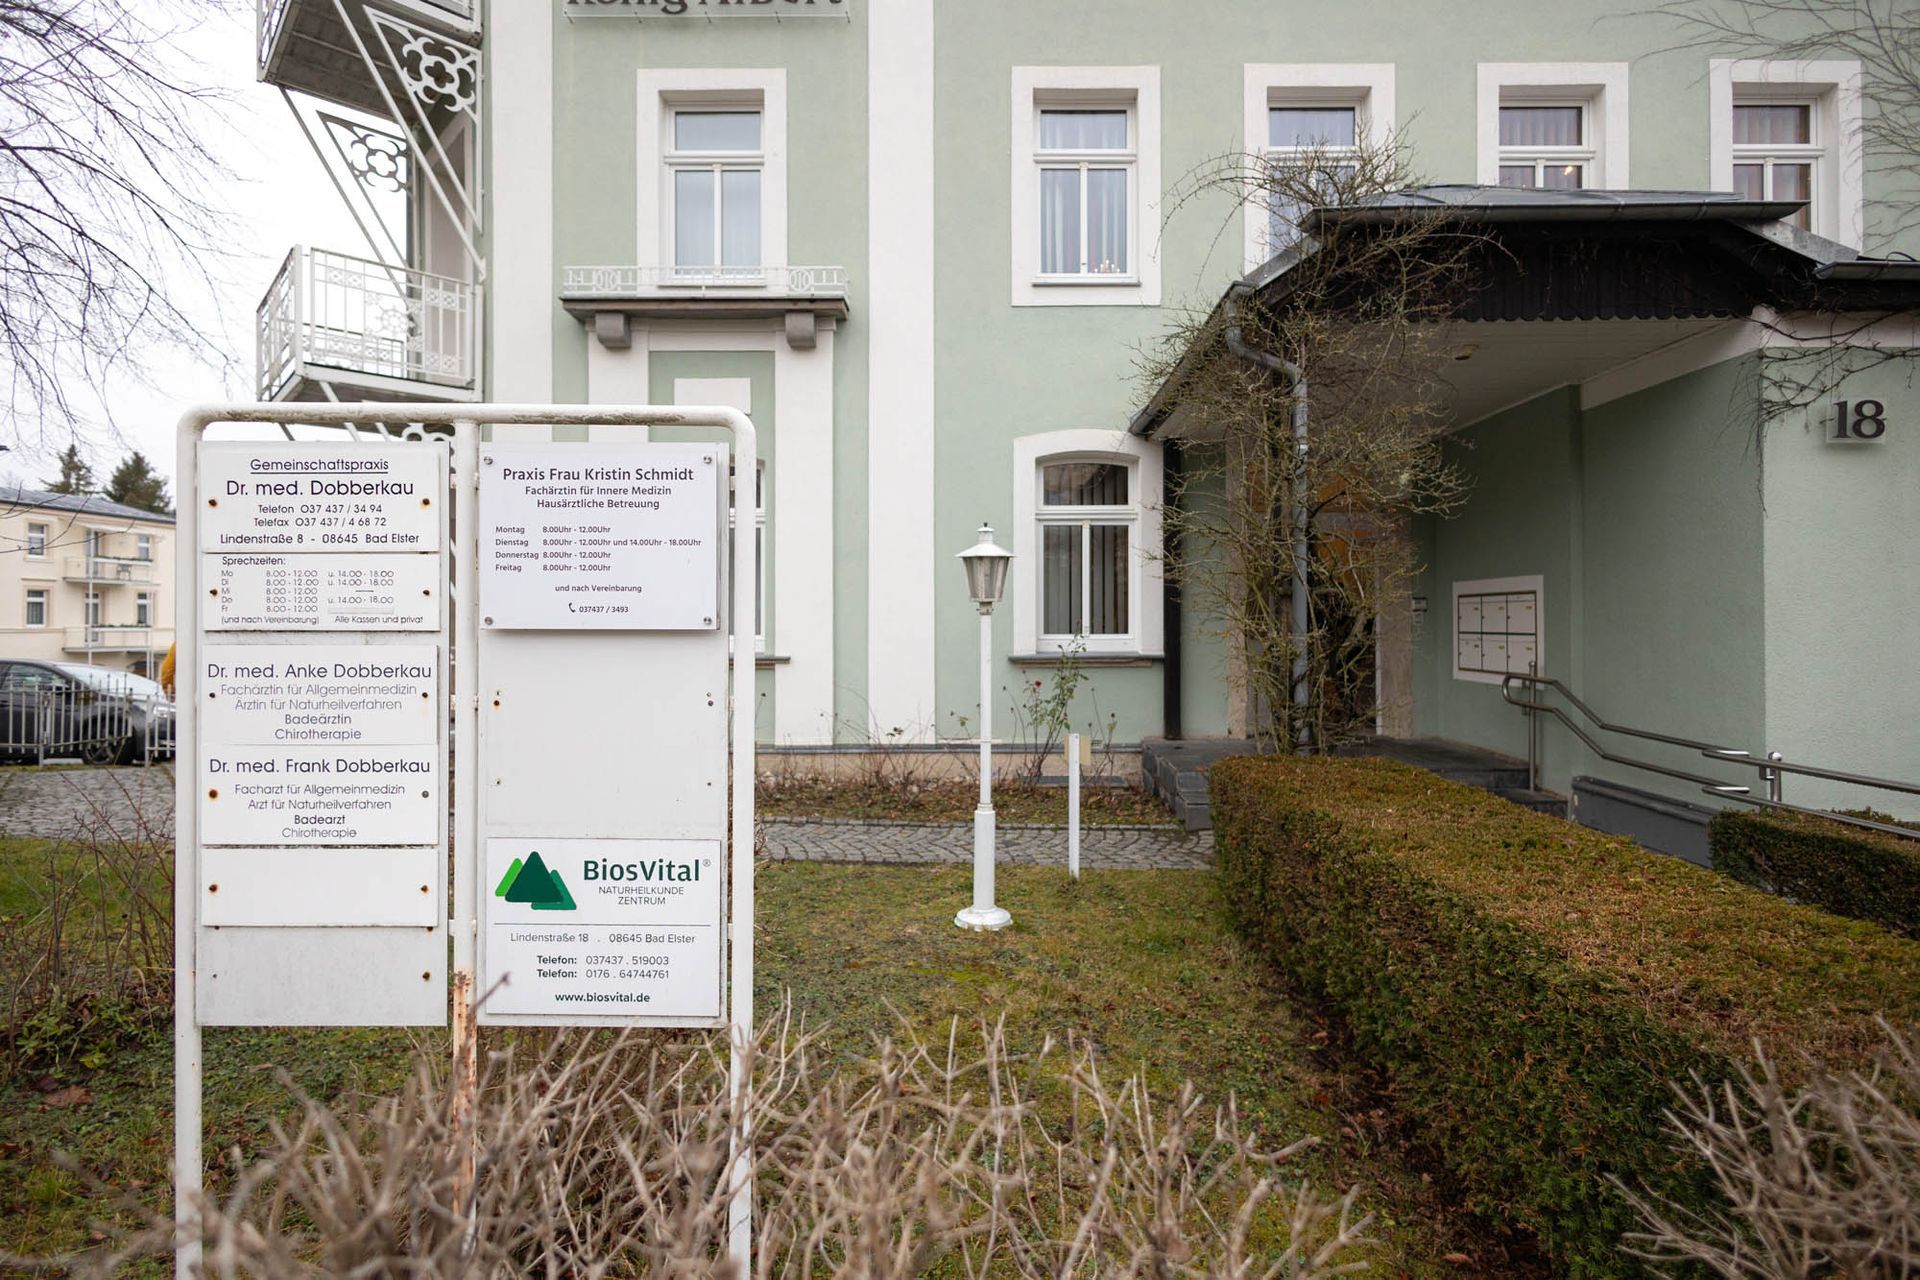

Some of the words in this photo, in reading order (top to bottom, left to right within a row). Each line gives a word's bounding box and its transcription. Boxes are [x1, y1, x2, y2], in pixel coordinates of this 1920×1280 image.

[1832, 399, 1886, 439] 18
[250, 458, 389, 473] Gemeinschaftspraxis
[504, 468, 545, 480] Praxis
[550, 468, 580, 480] Frau
[585, 468, 630, 480] Kristin
[636, 468, 693, 480] Schmidt
[227, 481, 248, 495] Dr.
[256, 481, 303, 495] med.
[311, 480, 413, 495] Dobberkau
[526, 486, 576, 495] Fachärztin
[580, 486, 594, 495] für
[597, 487, 628, 495] Innere
[632, 486, 671, 495] Medizin
[258, 505, 294, 513] Telefon
[325, 505, 344, 513] 437
[354, 504, 366, 513] 34
[370, 504, 382, 512] 94
[537, 499, 604, 508] Hausärztliche
[608, 499, 659, 510] Betreuung
[254, 518, 289, 526] Telefax
[320, 518, 338, 526] 437
[358, 518, 370, 526] 68
[375, 517, 386, 526] 72
[496, 526, 525, 534] Montag
[221, 534, 293, 544] Lindenstraße
[297, 534, 303, 543] 8
[322, 534, 358, 543] 08645
[366, 534, 387, 543] Bad
[392, 534, 419, 543] Elster
[496, 539, 528, 547] Dienstag
[223, 556, 285, 566] Sprechzeiten:
[496, 552, 539, 560] Donnerstag
[496, 564, 521, 572] Freitag
[591, 585, 642, 593] Vereinbarung
[208, 664, 227, 678] Dr.
[235, 664, 278, 678] med.
[285, 664, 327, 678] Anke
[334, 664, 431, 678] Dobberkau
[221, 684, 283, 698] Fachärztin
[288, 684, 302, 695] für
[306, 684, 416, 697] Allgemeinmedizin
[235, 699, 266, 710] Ärztin
[271, 699, 285, 710] für
[290, 699, 402, 710] Naturheilverfahren
[285, 713, 351, 724] Badeärztin
[275, 729, 361, 741] Chirotherapie
[210, 759, 229, 772] Dr.
[237, 759, 279, 773] med.
[287, 759, 330, 773] Frank
[336, 759, 430, 773] Dobberkau
[235, 784, 283, 794] Facharzt
[287, 784, 300, 794] für
[304, 784, 405, 796] Allgemeinmedizin
[248, 800, 268, 809] Arzt
[271, 800, 285, 809] für
[289, 800, 391, 809] Naturheilverfahren
[295, 815, 345, 824] Badearzt
[282, 828, 357, 839] Chirotherapie
[599, 886, 684, 895] NATURHEILKUNDE
[618, 897, 665, 905] ZENTRUM
[511, 933, 575, 942] Lindenstraße
[579, 933, 589, 942] 18
[609, 934, 642, 943] 08645
[646, 934, 664, 943] Bad
[668, 934, 695, 943] Elster
[537, 955, 576, 964] Telefon:
[586, 956, 623, 964] 037437
[632, 956, 669, 965] 519003
[537, 969, 576, 978] Telefon:
[586, 969, 610, 978] 0176
[619, 970, 668, 979] 64744761
[555, 992, 650, 1002] www.biosvital.de
